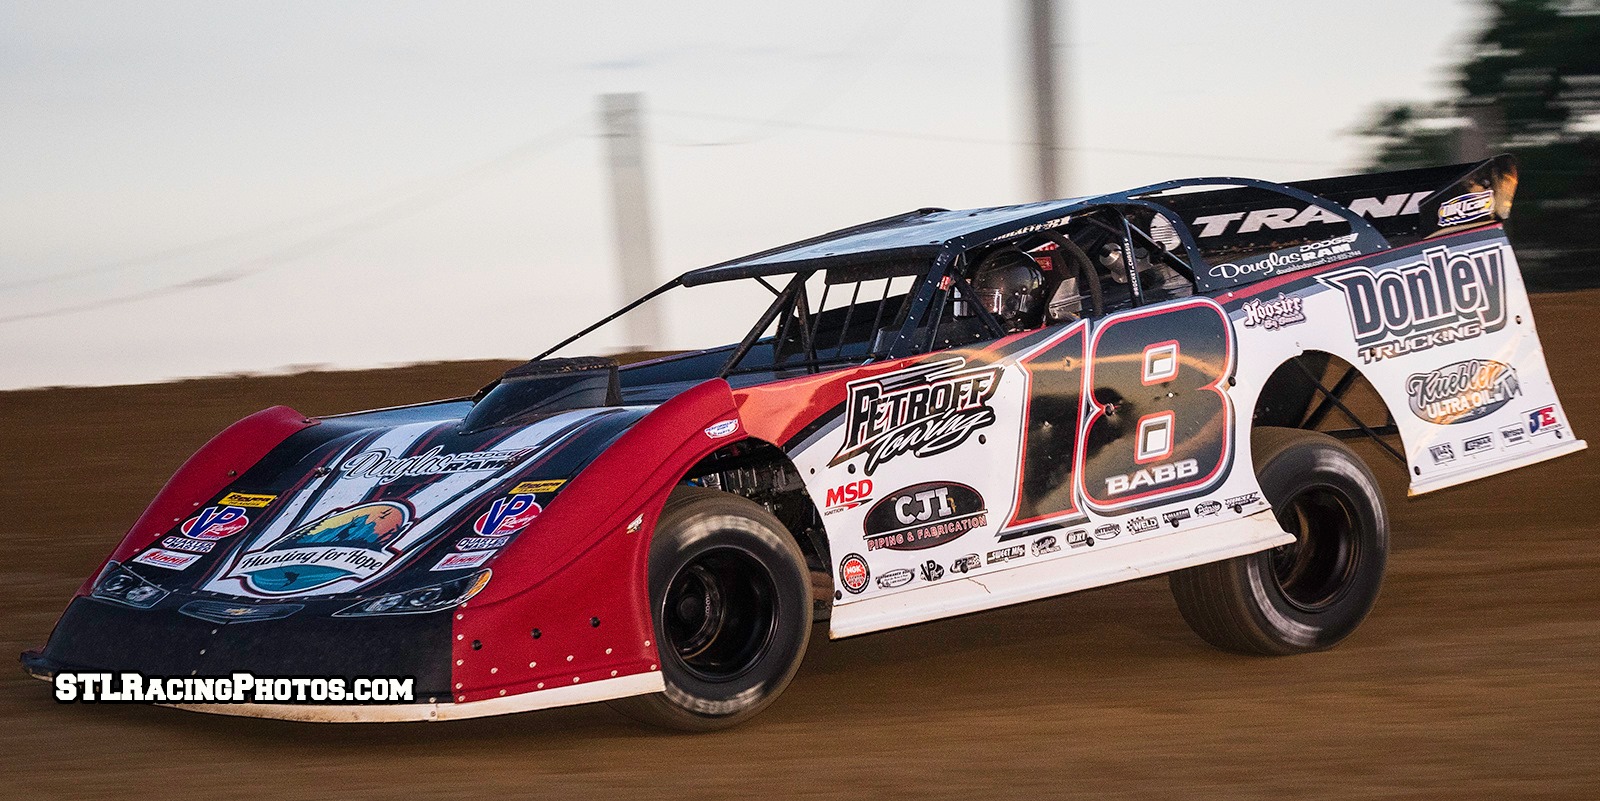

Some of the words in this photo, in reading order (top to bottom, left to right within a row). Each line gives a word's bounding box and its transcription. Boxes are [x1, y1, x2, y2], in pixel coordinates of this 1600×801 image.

[1208, 252, 1300, 276] Douglas
[1301, 243, 1352, 262] RAM
[1243, 292, 1303, 327] Hoosier
[1332, 246, 1506, 341] Donley
[1358, 321, 1484, 364] TRUCKING
[844, 371, 1000, 452] PETROFF
[999, 299, 1235, 532] 18
[1426, 397, 1470, 418] ULTRA
[1471, 389, 1495, 408] OIL
[1529, 406, 1557, 433] JE
[866, 408, 993, 472] Towing
[342, 446, 449, 484] Douglas
[443, 459, 503, 472] RAM
[1105, 458, 1199, 495] BABB
[825, 479, 873, 508] MSD
[894, 486, 952, 525] CJI
[185, 505, 247, 538] VP
[480, 493, 535, 536] VP
[1132, 518, 1157, 531] WELD
[867, 534, 904, 552] PIPING
[906, 531, 915, 542] &
[917, 514, 988, 540] FABRICATION
[241, 550, 315, 570] Hunting
[311, 549, 347, 563] for
[345, 549, 383, 571] Hope
[846, 566, 862, 574] NGK
[991, 547, 1011, 560] SWEET
